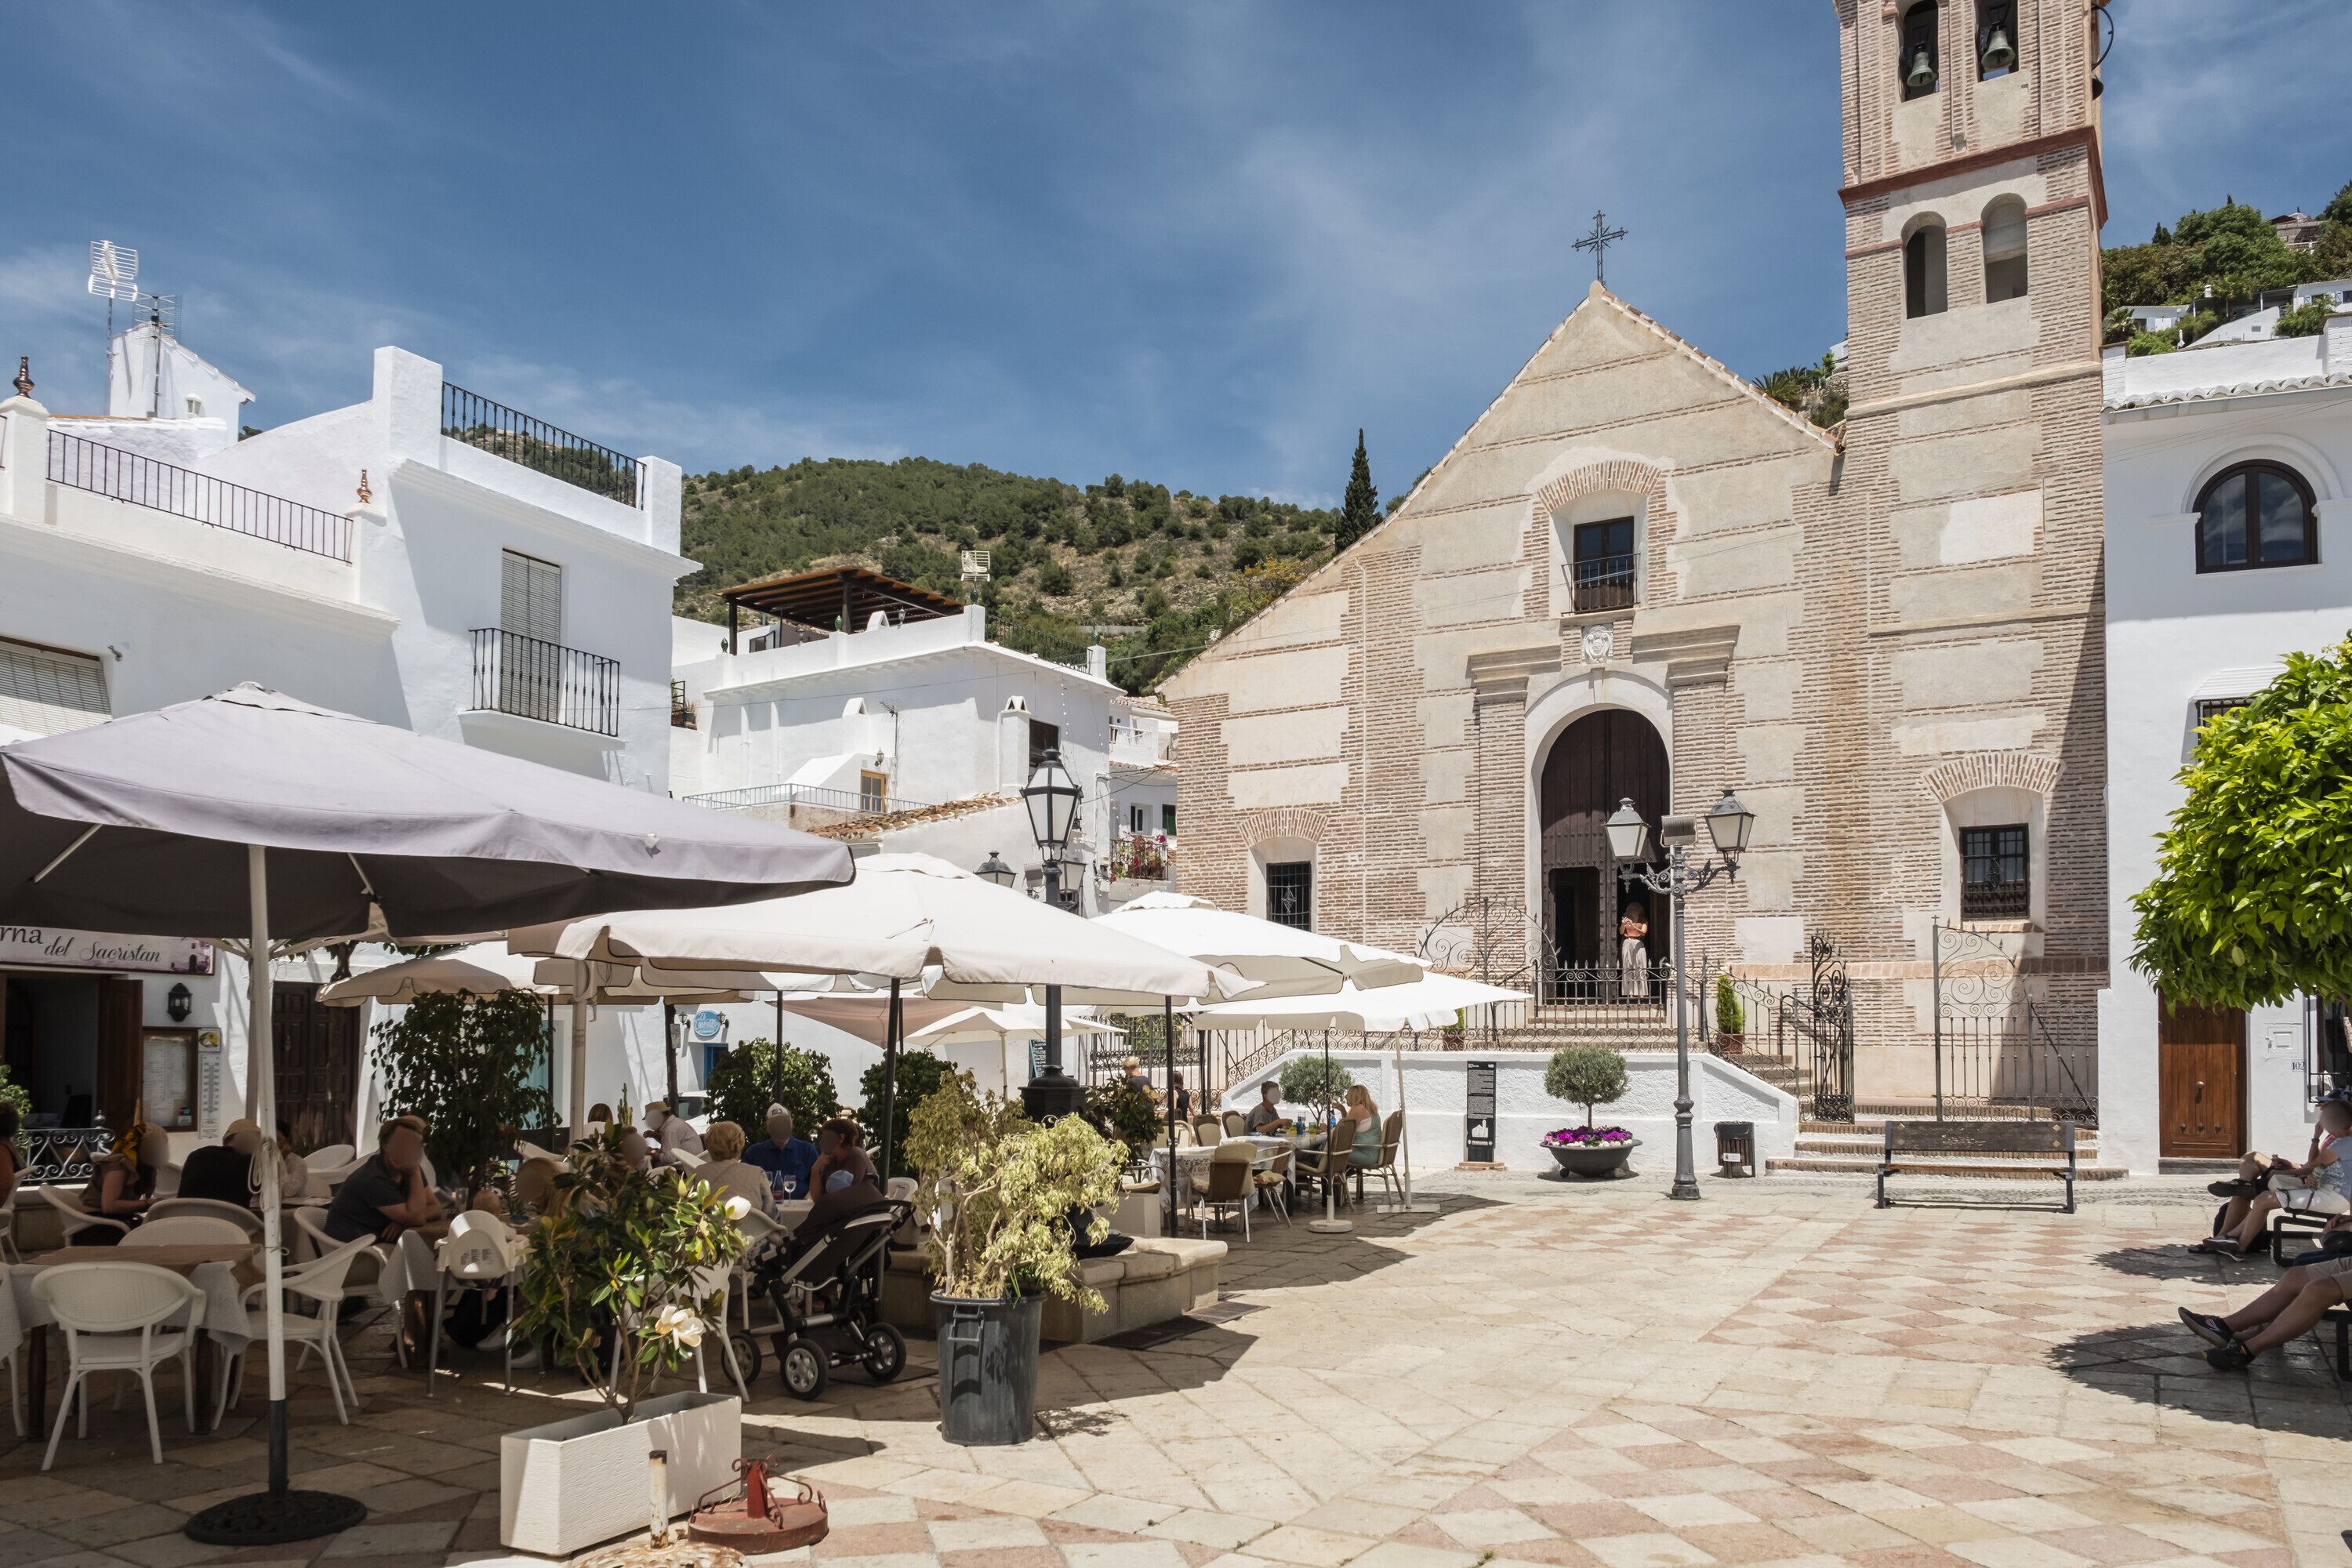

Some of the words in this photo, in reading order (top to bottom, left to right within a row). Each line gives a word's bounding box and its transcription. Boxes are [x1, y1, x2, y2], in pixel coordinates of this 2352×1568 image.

[45, 936, 74, 956] del
[80, 941, 162, 963] Sacristan
[2292, 1062, 2305, 1070] 102
